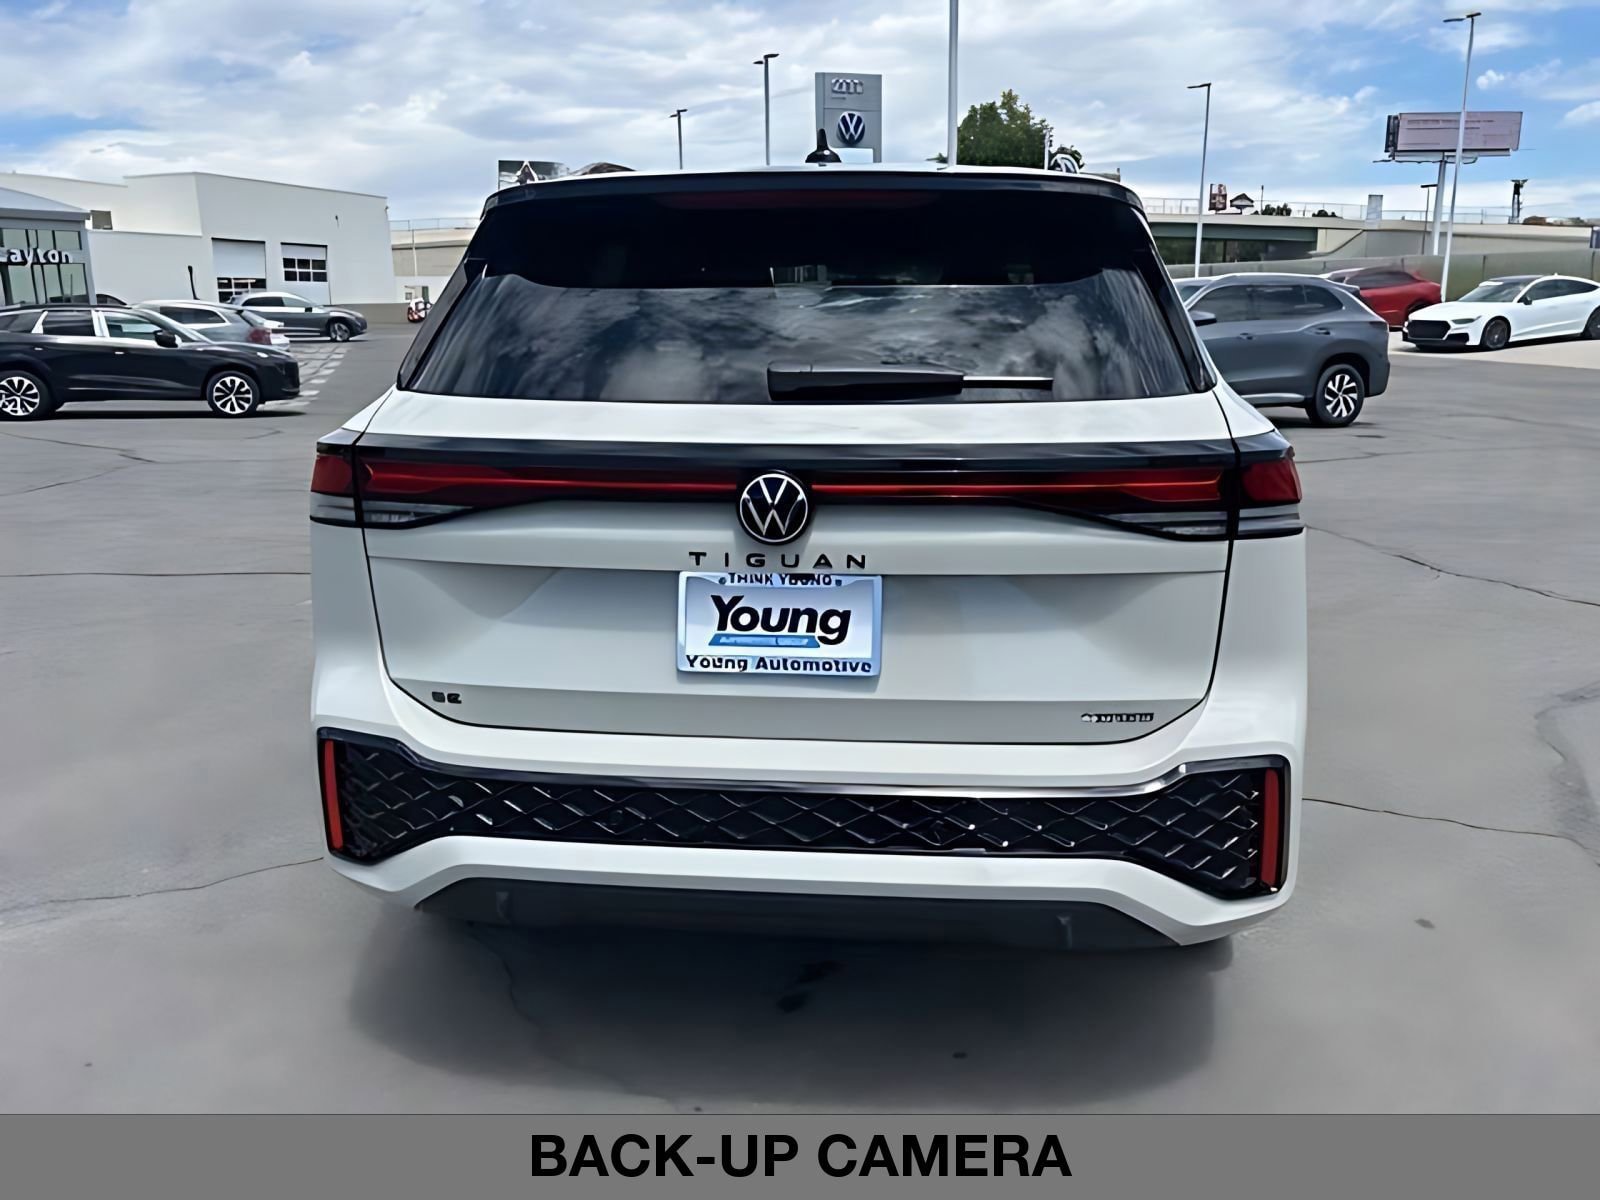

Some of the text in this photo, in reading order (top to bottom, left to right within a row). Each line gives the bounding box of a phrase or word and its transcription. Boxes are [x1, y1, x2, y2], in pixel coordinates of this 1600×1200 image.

[689, 551, 866, 569] TIGUAN
[711, 595, 851, 646] Young
[686, 655, 872, 673] Young Automotive
